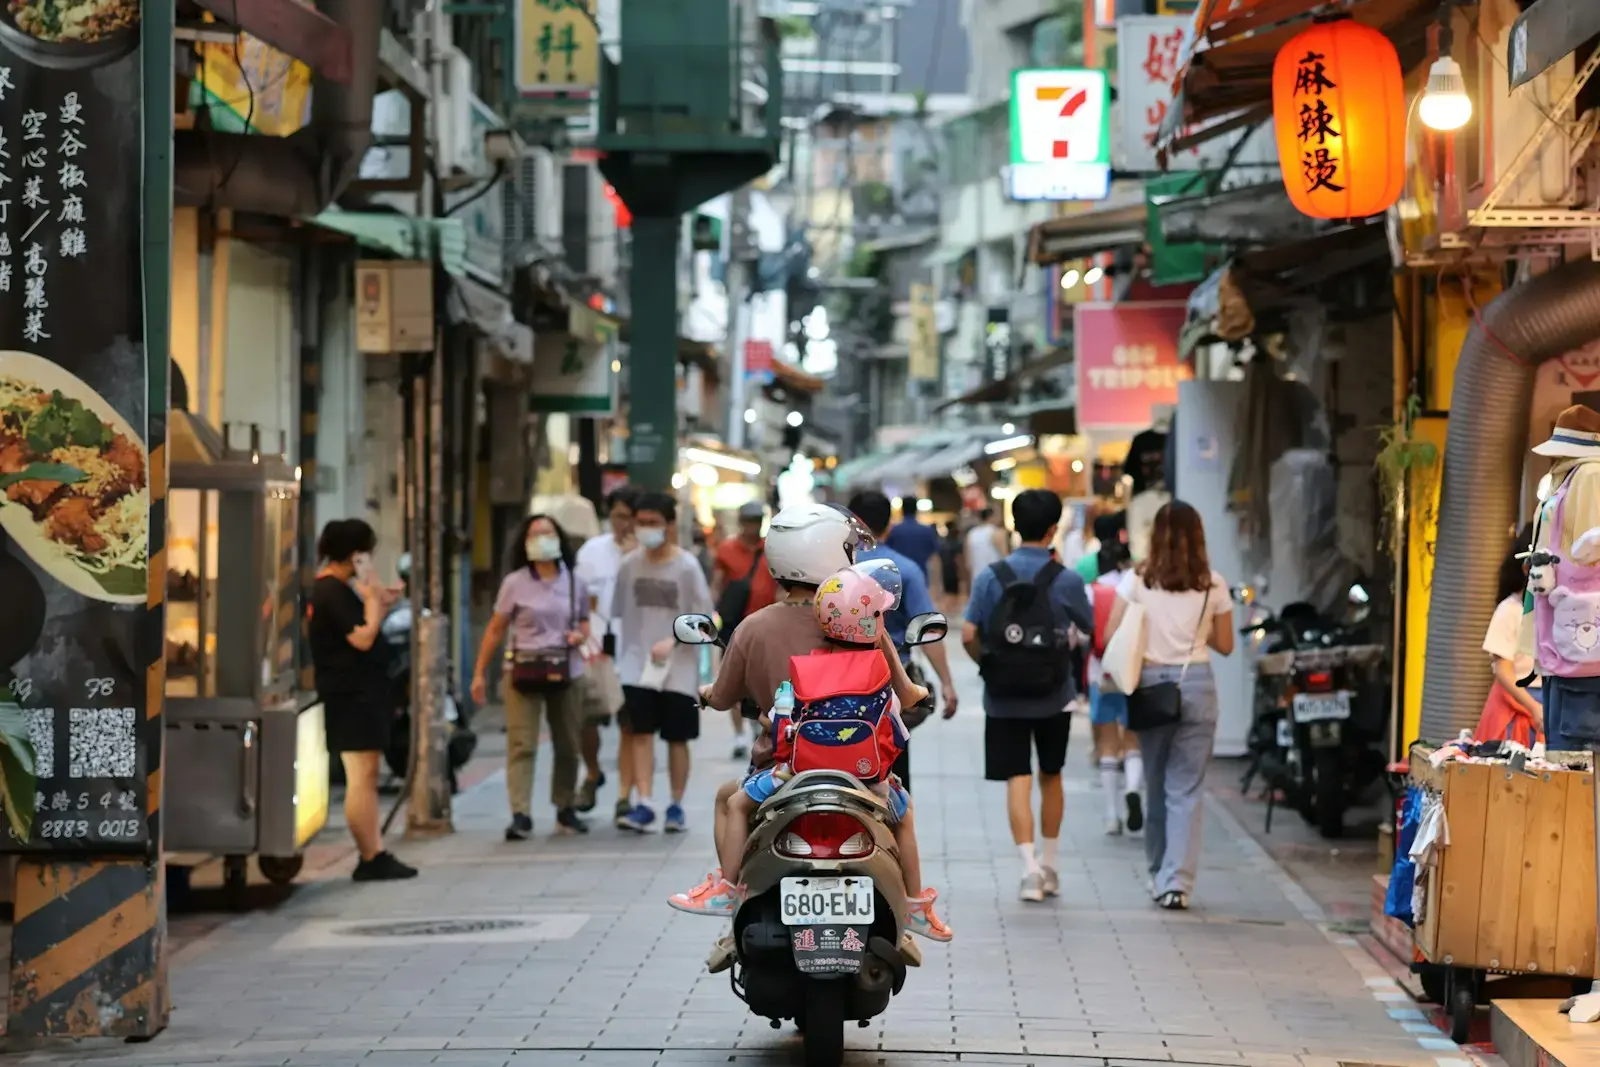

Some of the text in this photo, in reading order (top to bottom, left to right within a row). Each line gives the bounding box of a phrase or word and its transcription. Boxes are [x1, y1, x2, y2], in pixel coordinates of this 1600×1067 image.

[1293, 51, 1346, 194] 麻辣燙
[57, 91, 88, 257] 曼谷椒麻雞
[84, 677, 115, 699] FB
[41, 819, 89, 838] 2883
[98, 819, 140, 838] 0013
[794, 928, 819, 951] 進
